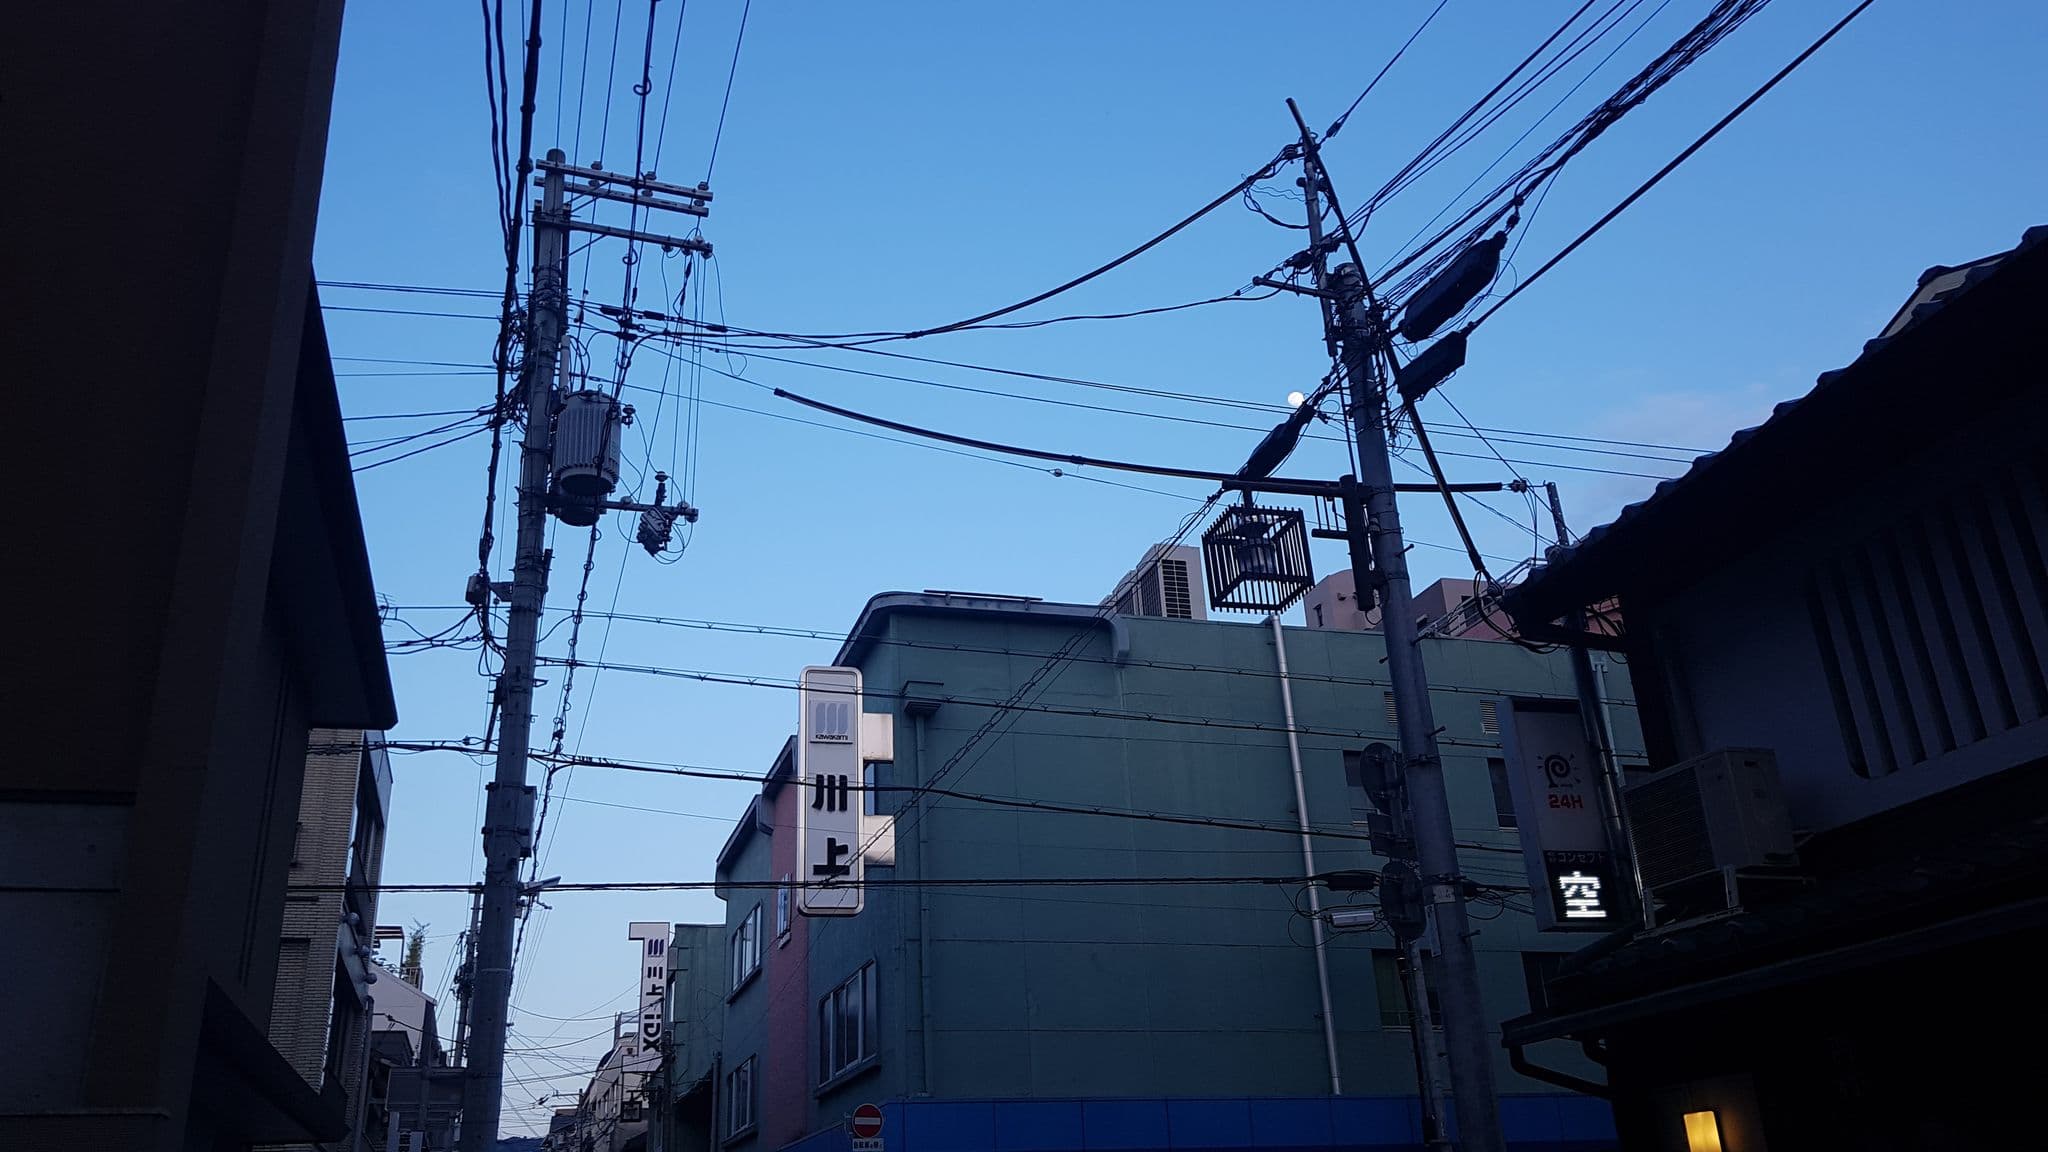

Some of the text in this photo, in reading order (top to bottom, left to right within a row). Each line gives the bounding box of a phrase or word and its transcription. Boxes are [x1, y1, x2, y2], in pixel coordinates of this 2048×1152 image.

[1548, 794, 1584, 809] 24H
[812, 774, 850, 875] 川上
[1558, 870, 1607, 918] 空
[646, 965, 664, 996] 川上
